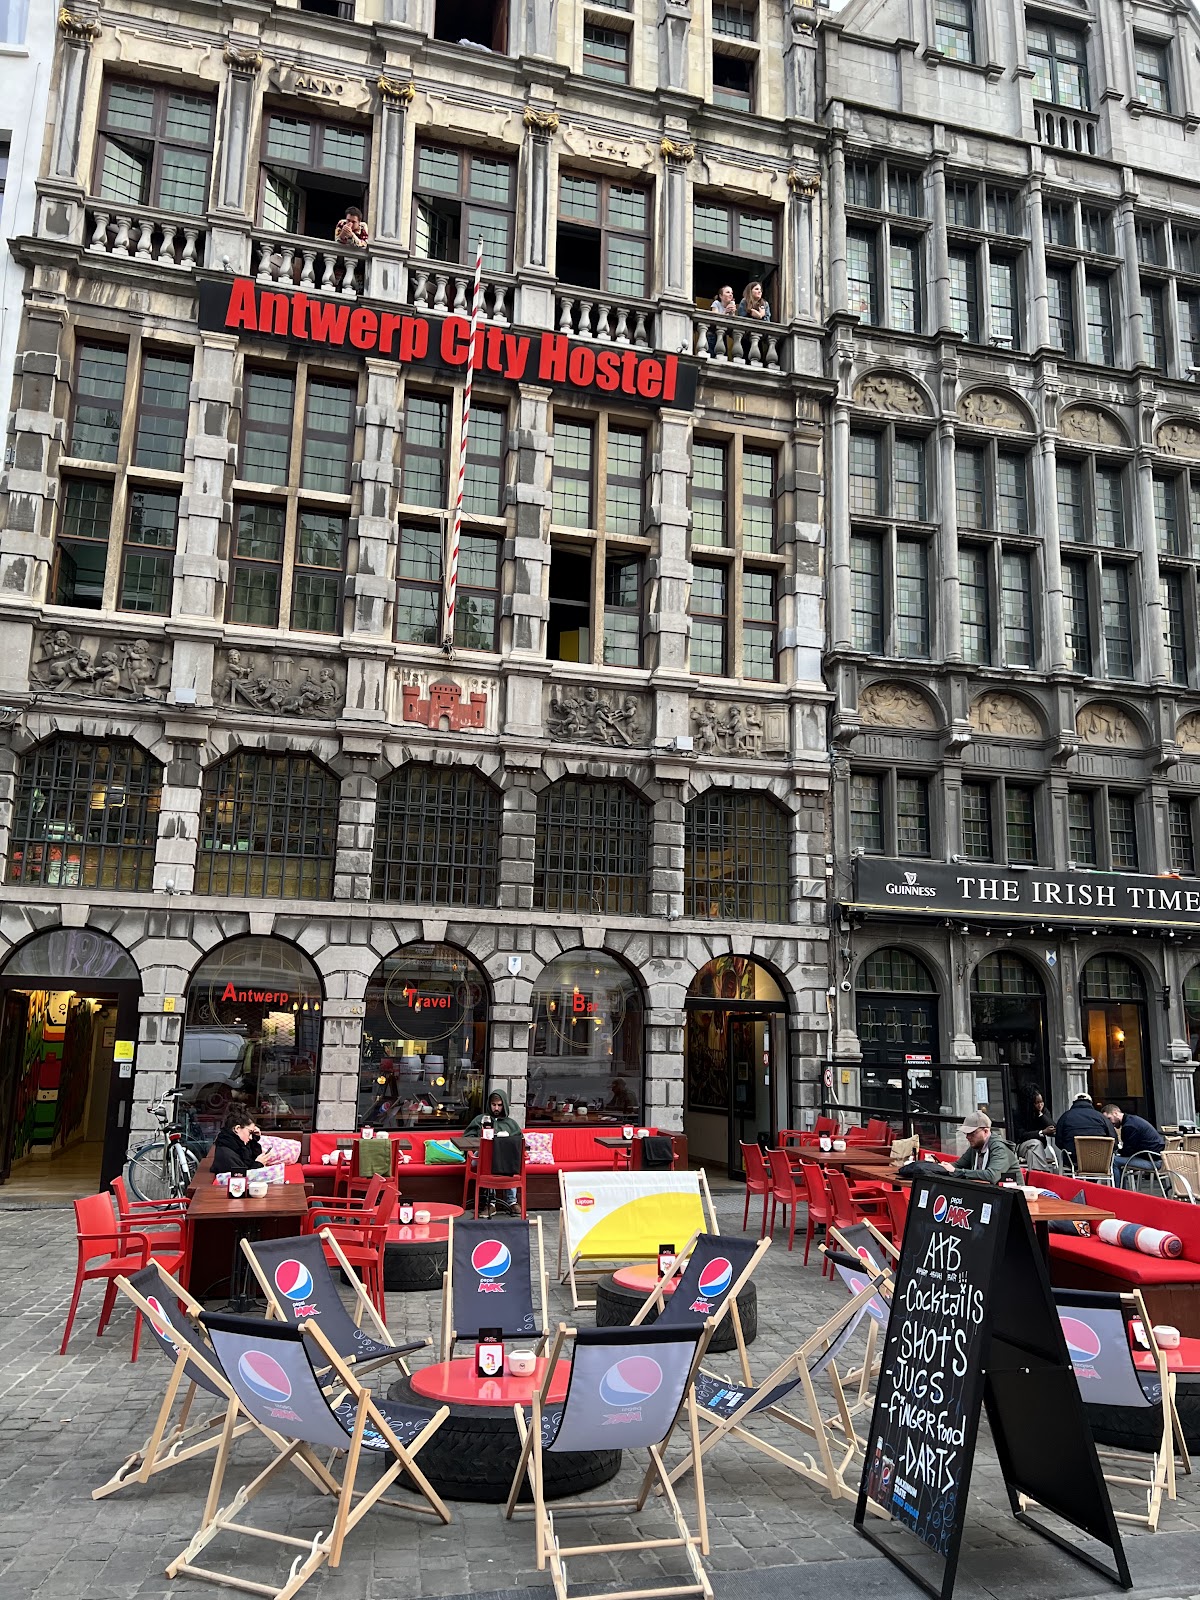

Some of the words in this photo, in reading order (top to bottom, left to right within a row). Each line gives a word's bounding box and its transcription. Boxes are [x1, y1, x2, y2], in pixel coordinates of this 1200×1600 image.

[295, 76, 344, 96] ANNO
[225, 277, 430, 362] Antwerp
[440, 315, 530, 381] City
[538, 332, 679, 401] Hostel
[886, 883, 937, 897] GUINNESS
[956, 877, 1020, 902] THE
[1032, 881, 1116, 907] IRISH
[1126, 887, 1200, 911] TIME
[221, 981, 289, 1006] Antwerp
[406, 988, 451, 1009] Travel
[573, 993, 599, 1012] Bar
